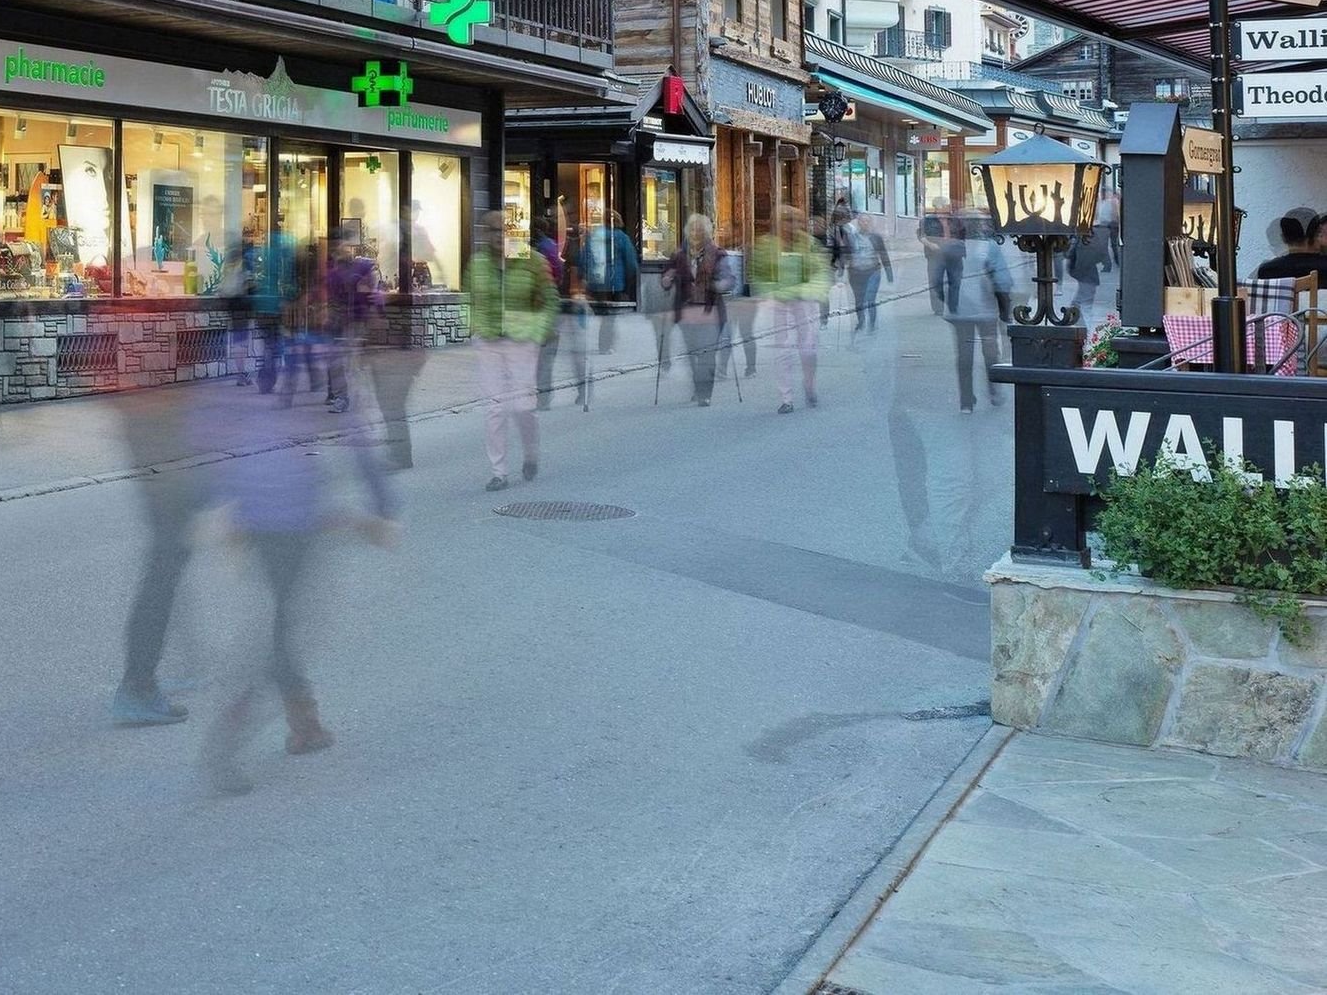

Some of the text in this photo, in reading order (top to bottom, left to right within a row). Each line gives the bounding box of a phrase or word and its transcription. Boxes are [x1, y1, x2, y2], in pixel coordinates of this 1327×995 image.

[4, 46, 106, 88] pharmacie
[206, 86, 301, 120] TESTA GRIGIA
[746, 82, 776, 108] HUBLOT
[387, 106, 450, 132] parfumerie
[1061, 407, 1327, 489] WALL
